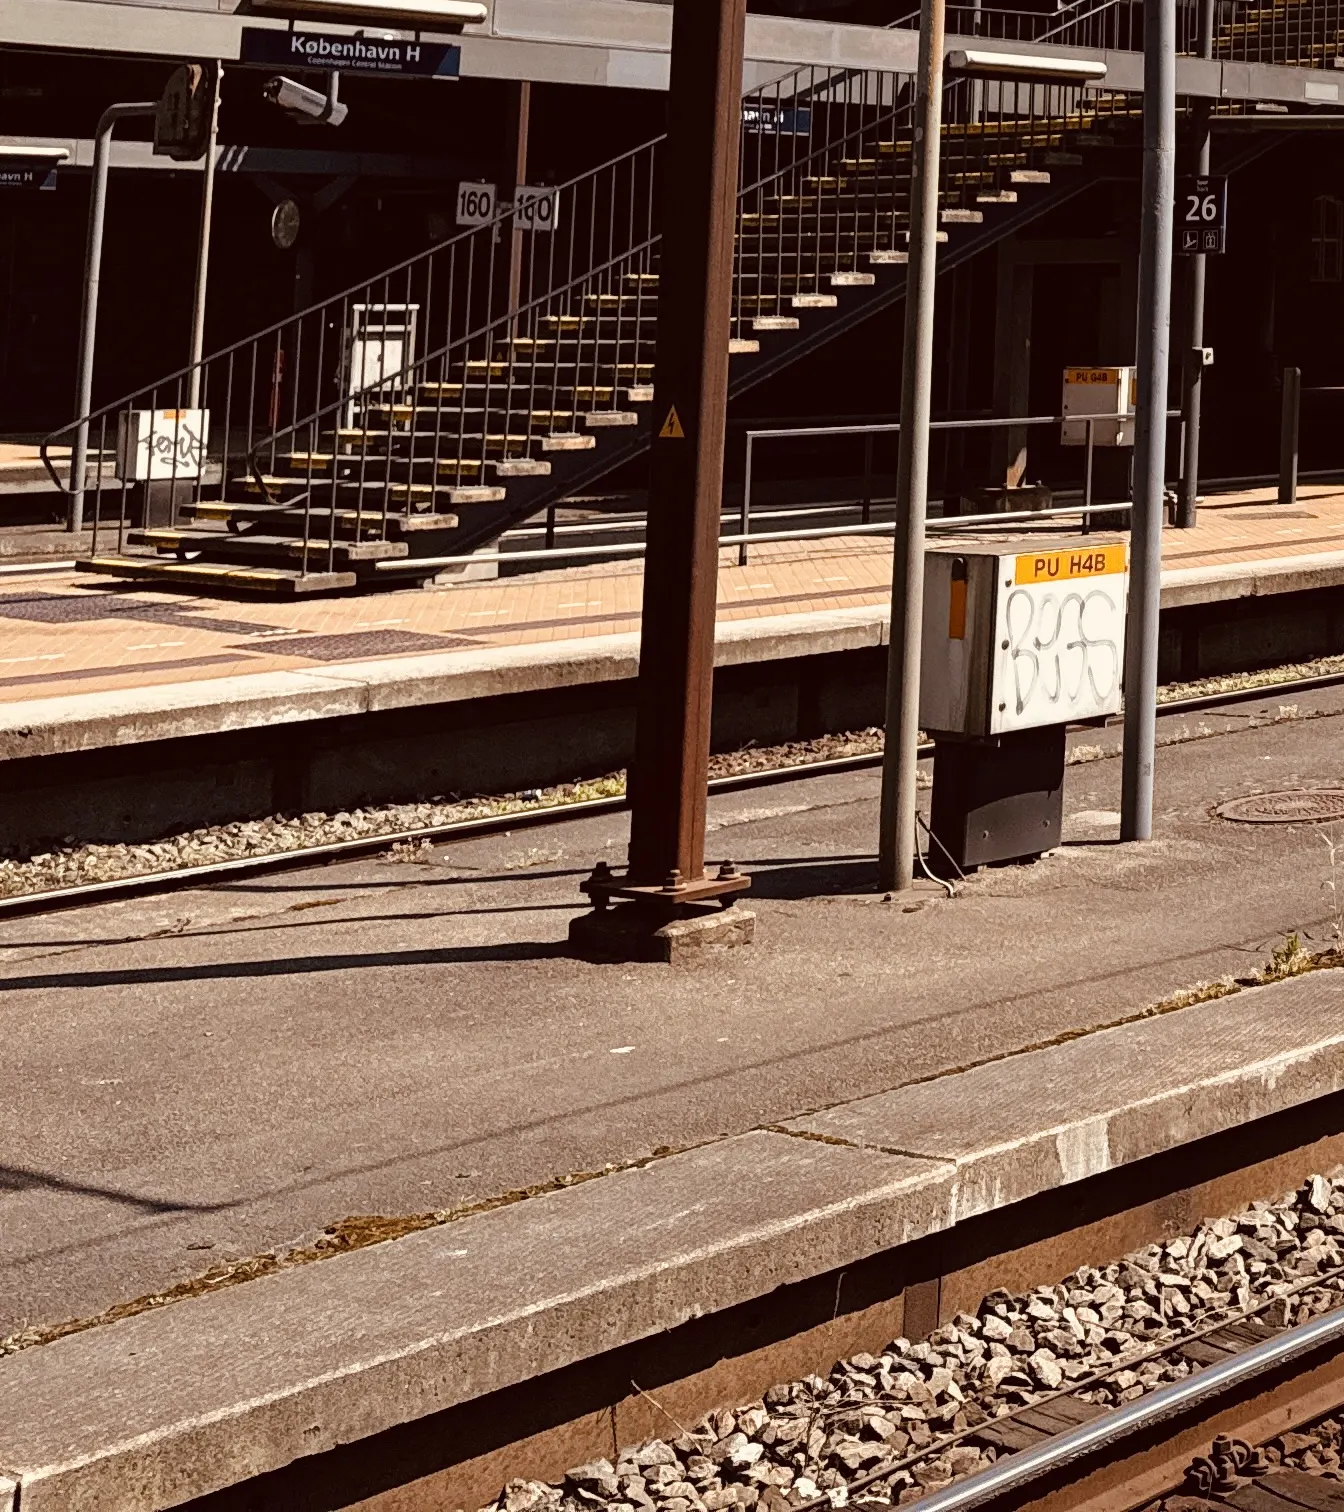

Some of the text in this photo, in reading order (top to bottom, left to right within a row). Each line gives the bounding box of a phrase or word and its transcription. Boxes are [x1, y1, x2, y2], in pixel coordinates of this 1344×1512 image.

[291, 35, 421, 63] København H
[460, 190, 491, 218] 160
[1185, 194, 1217, 221] 26
[1034, 553, 1107, 578] PU H4B
